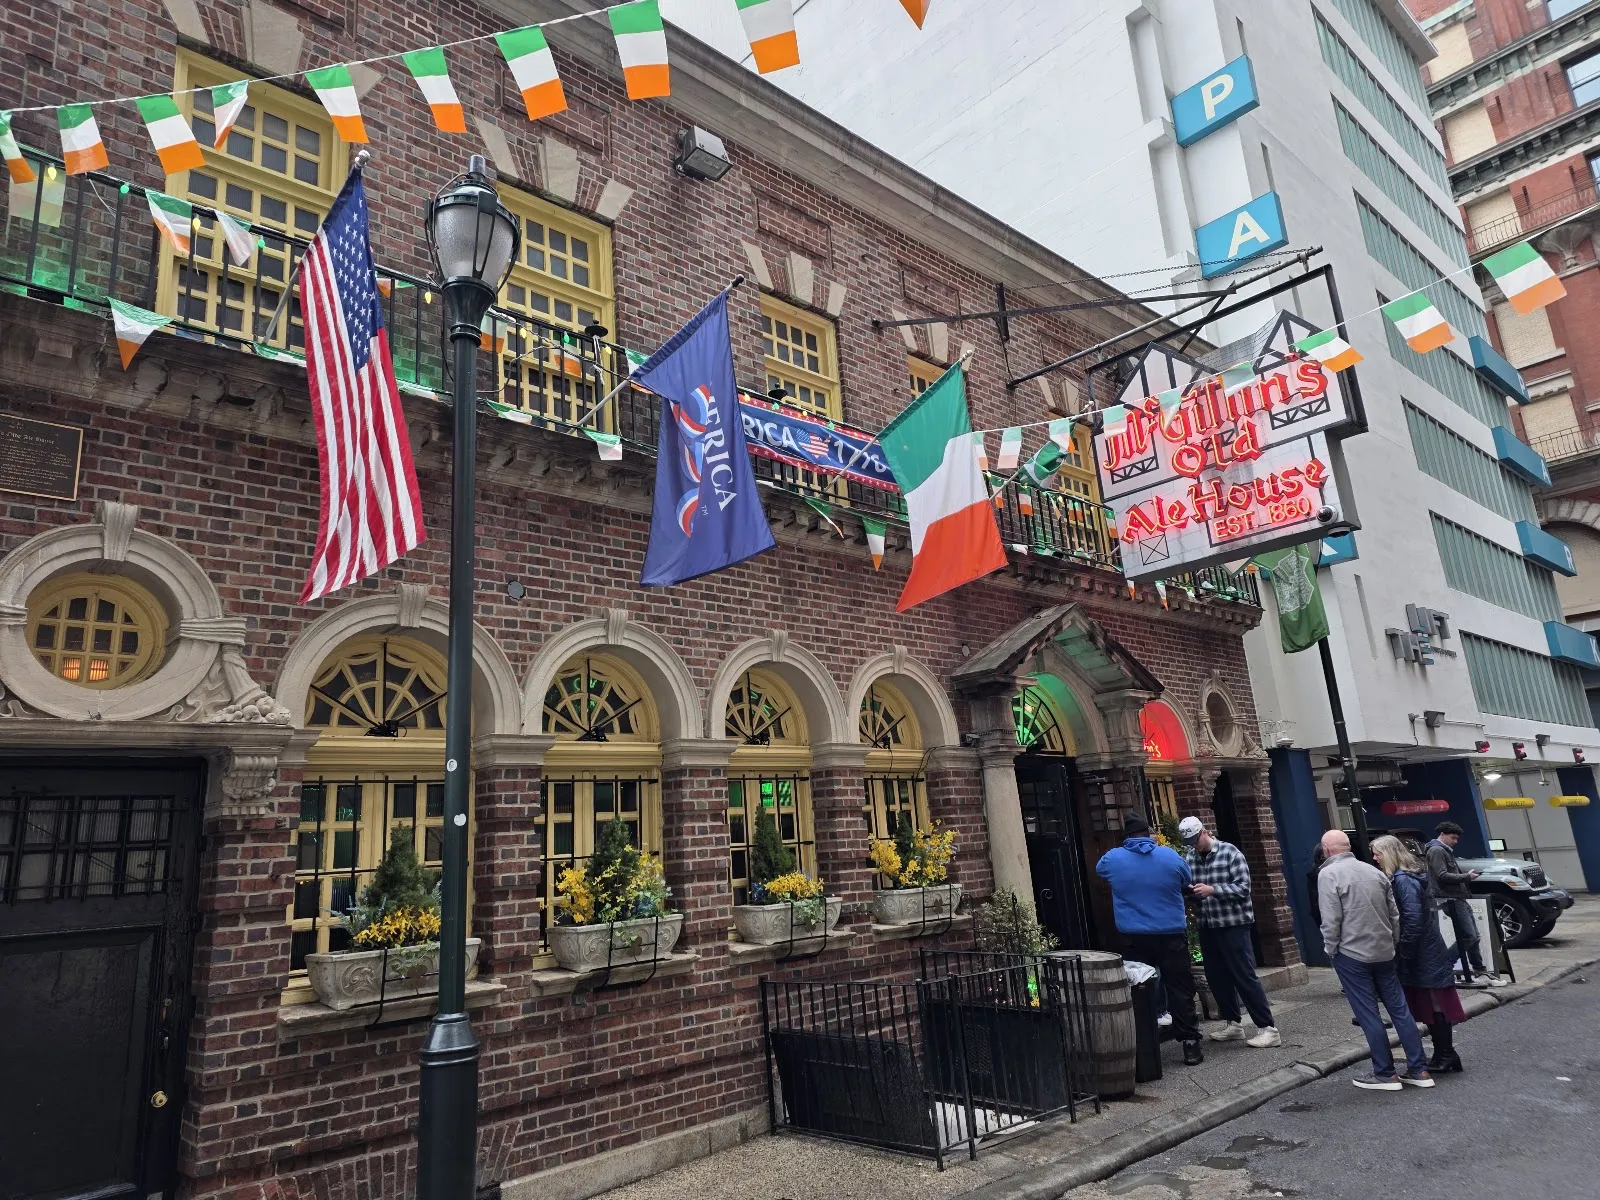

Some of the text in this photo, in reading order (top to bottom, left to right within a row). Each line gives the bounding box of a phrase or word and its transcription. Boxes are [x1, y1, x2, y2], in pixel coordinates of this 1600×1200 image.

[1201, 73, 1234, 121] P
[1227, 210, 1270, 259] A
[1172, 416, 1264, 478] Old
[1121, 457, 1328, 544] Ale House
[1266, 497, 1312, 523] 1860
[1385, 628, 1434, 665] THE
